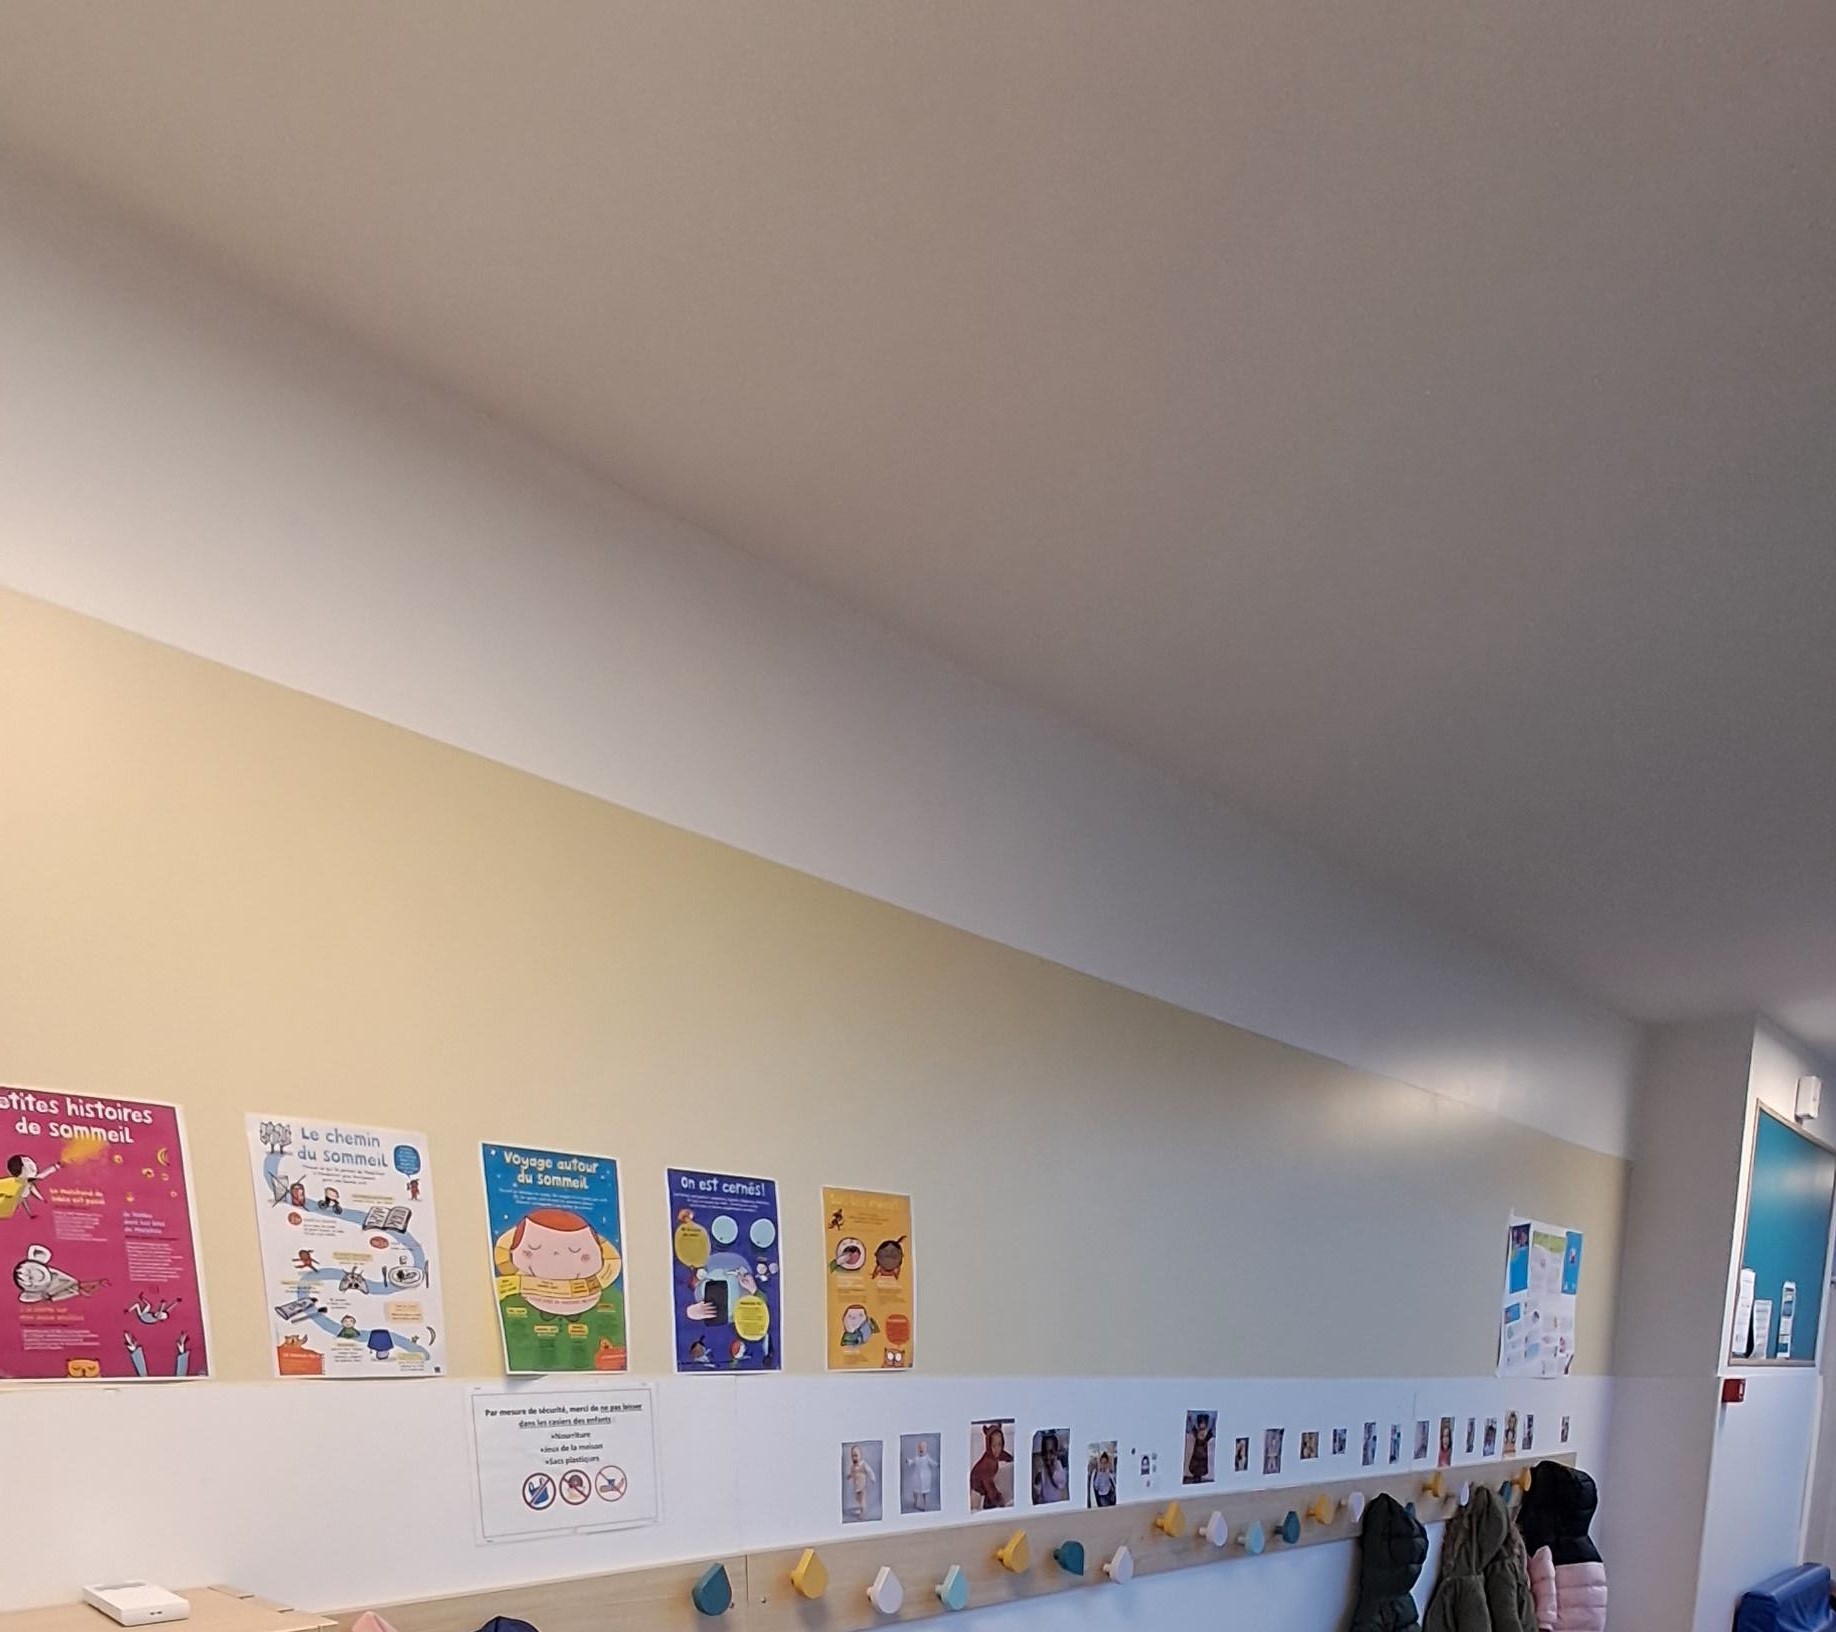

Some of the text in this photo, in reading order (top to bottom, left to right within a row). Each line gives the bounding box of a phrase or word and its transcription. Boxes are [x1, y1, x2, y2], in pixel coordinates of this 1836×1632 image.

[66, 1097, 153, 1124] histoires
[15, 1116, 134, 1143] de sommeil
[301, 1127, 381, 1148] Le chemin
[297, 1145, 317, 1161] du
[323, 1150, 389, 1168] sommeil
[503, 1151, 599, 1173] Voyage autour
[517, 1170, 589, 1190] du sommeil
[681, 1176, 696, 1190] On
[699, 1178, 719, 1192] est
[528, 1406, 537, 1414] de
